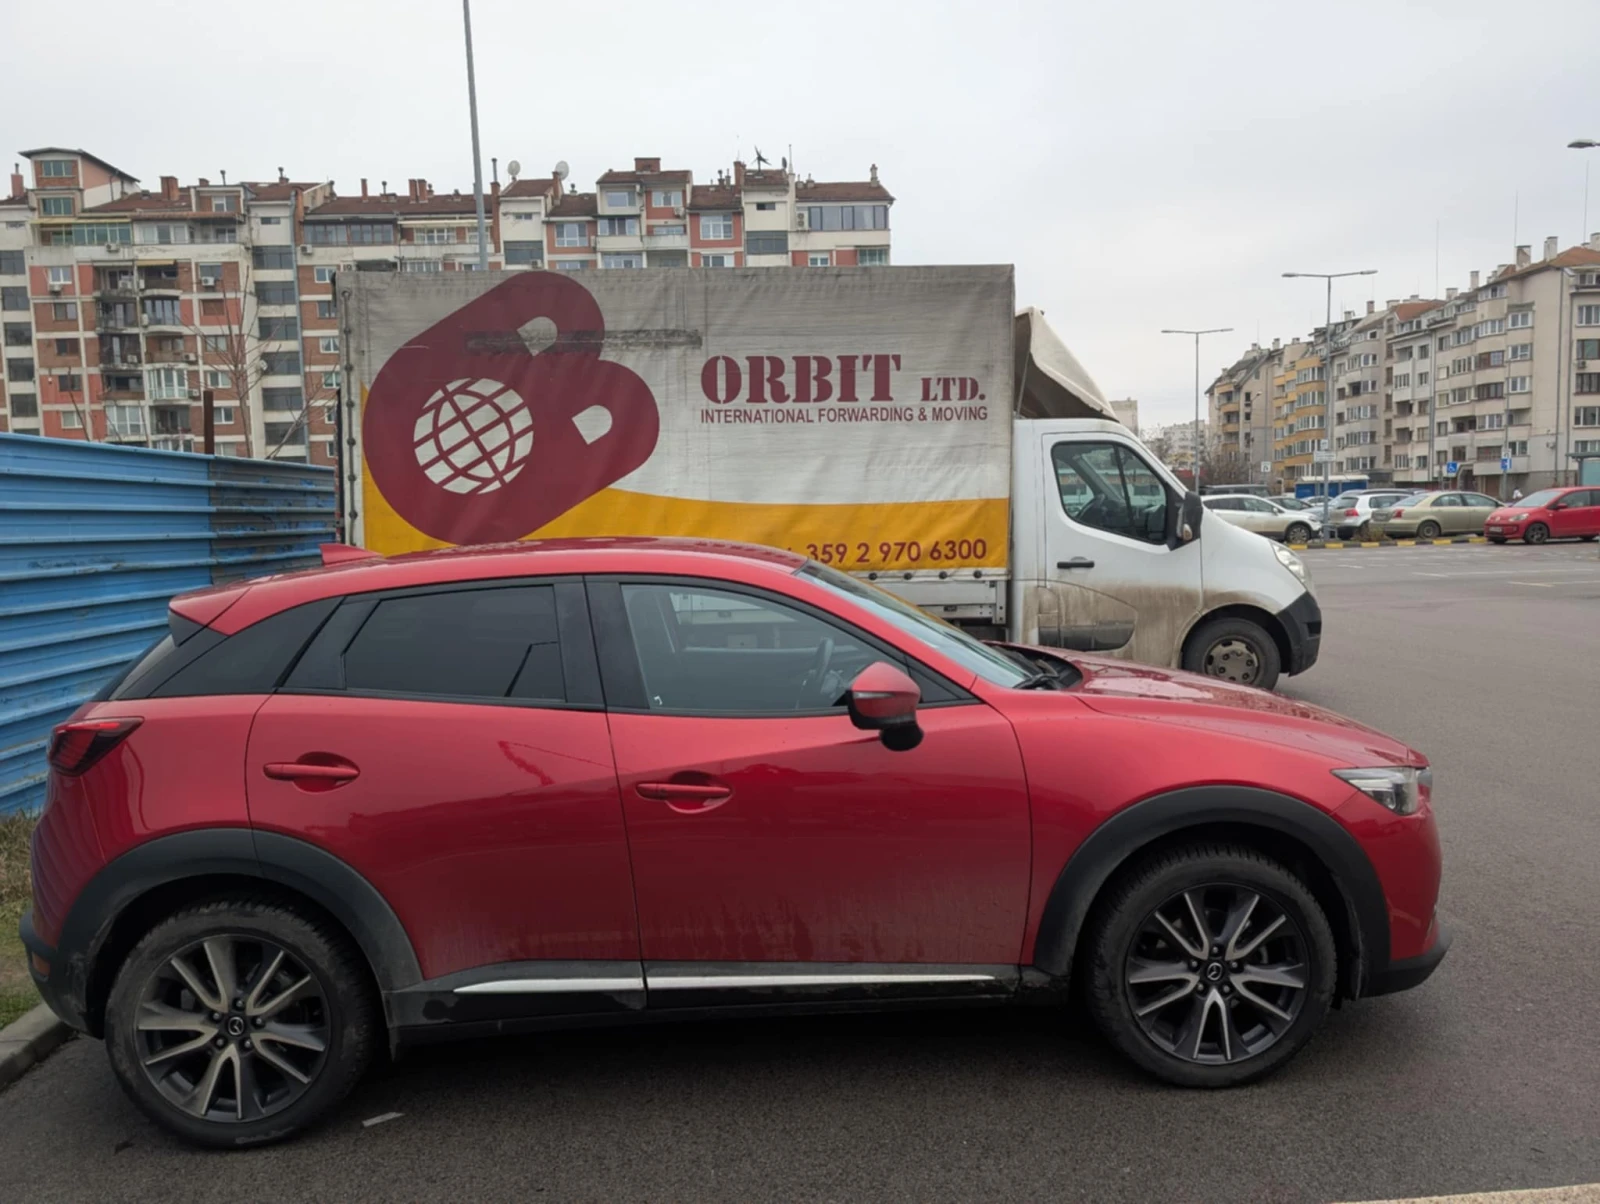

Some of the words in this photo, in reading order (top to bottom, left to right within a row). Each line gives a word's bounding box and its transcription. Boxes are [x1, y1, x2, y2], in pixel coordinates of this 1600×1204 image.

[700, 354, 902, 404] ORBIT
[920, 377, 986, 402] LTD.
[700, 408, 814, 424] INTERNATIONAL
[818, 407, 913, 423] FORWARDING
[917, 407, 928, 422] &
[931, 406, 988, 421] MOVING
[806, 543, 848, 564] 359
[856, 542, 870, 563] 2
[878, 541, 922, 562] 970
[929, 539, 987, 561] 6300
